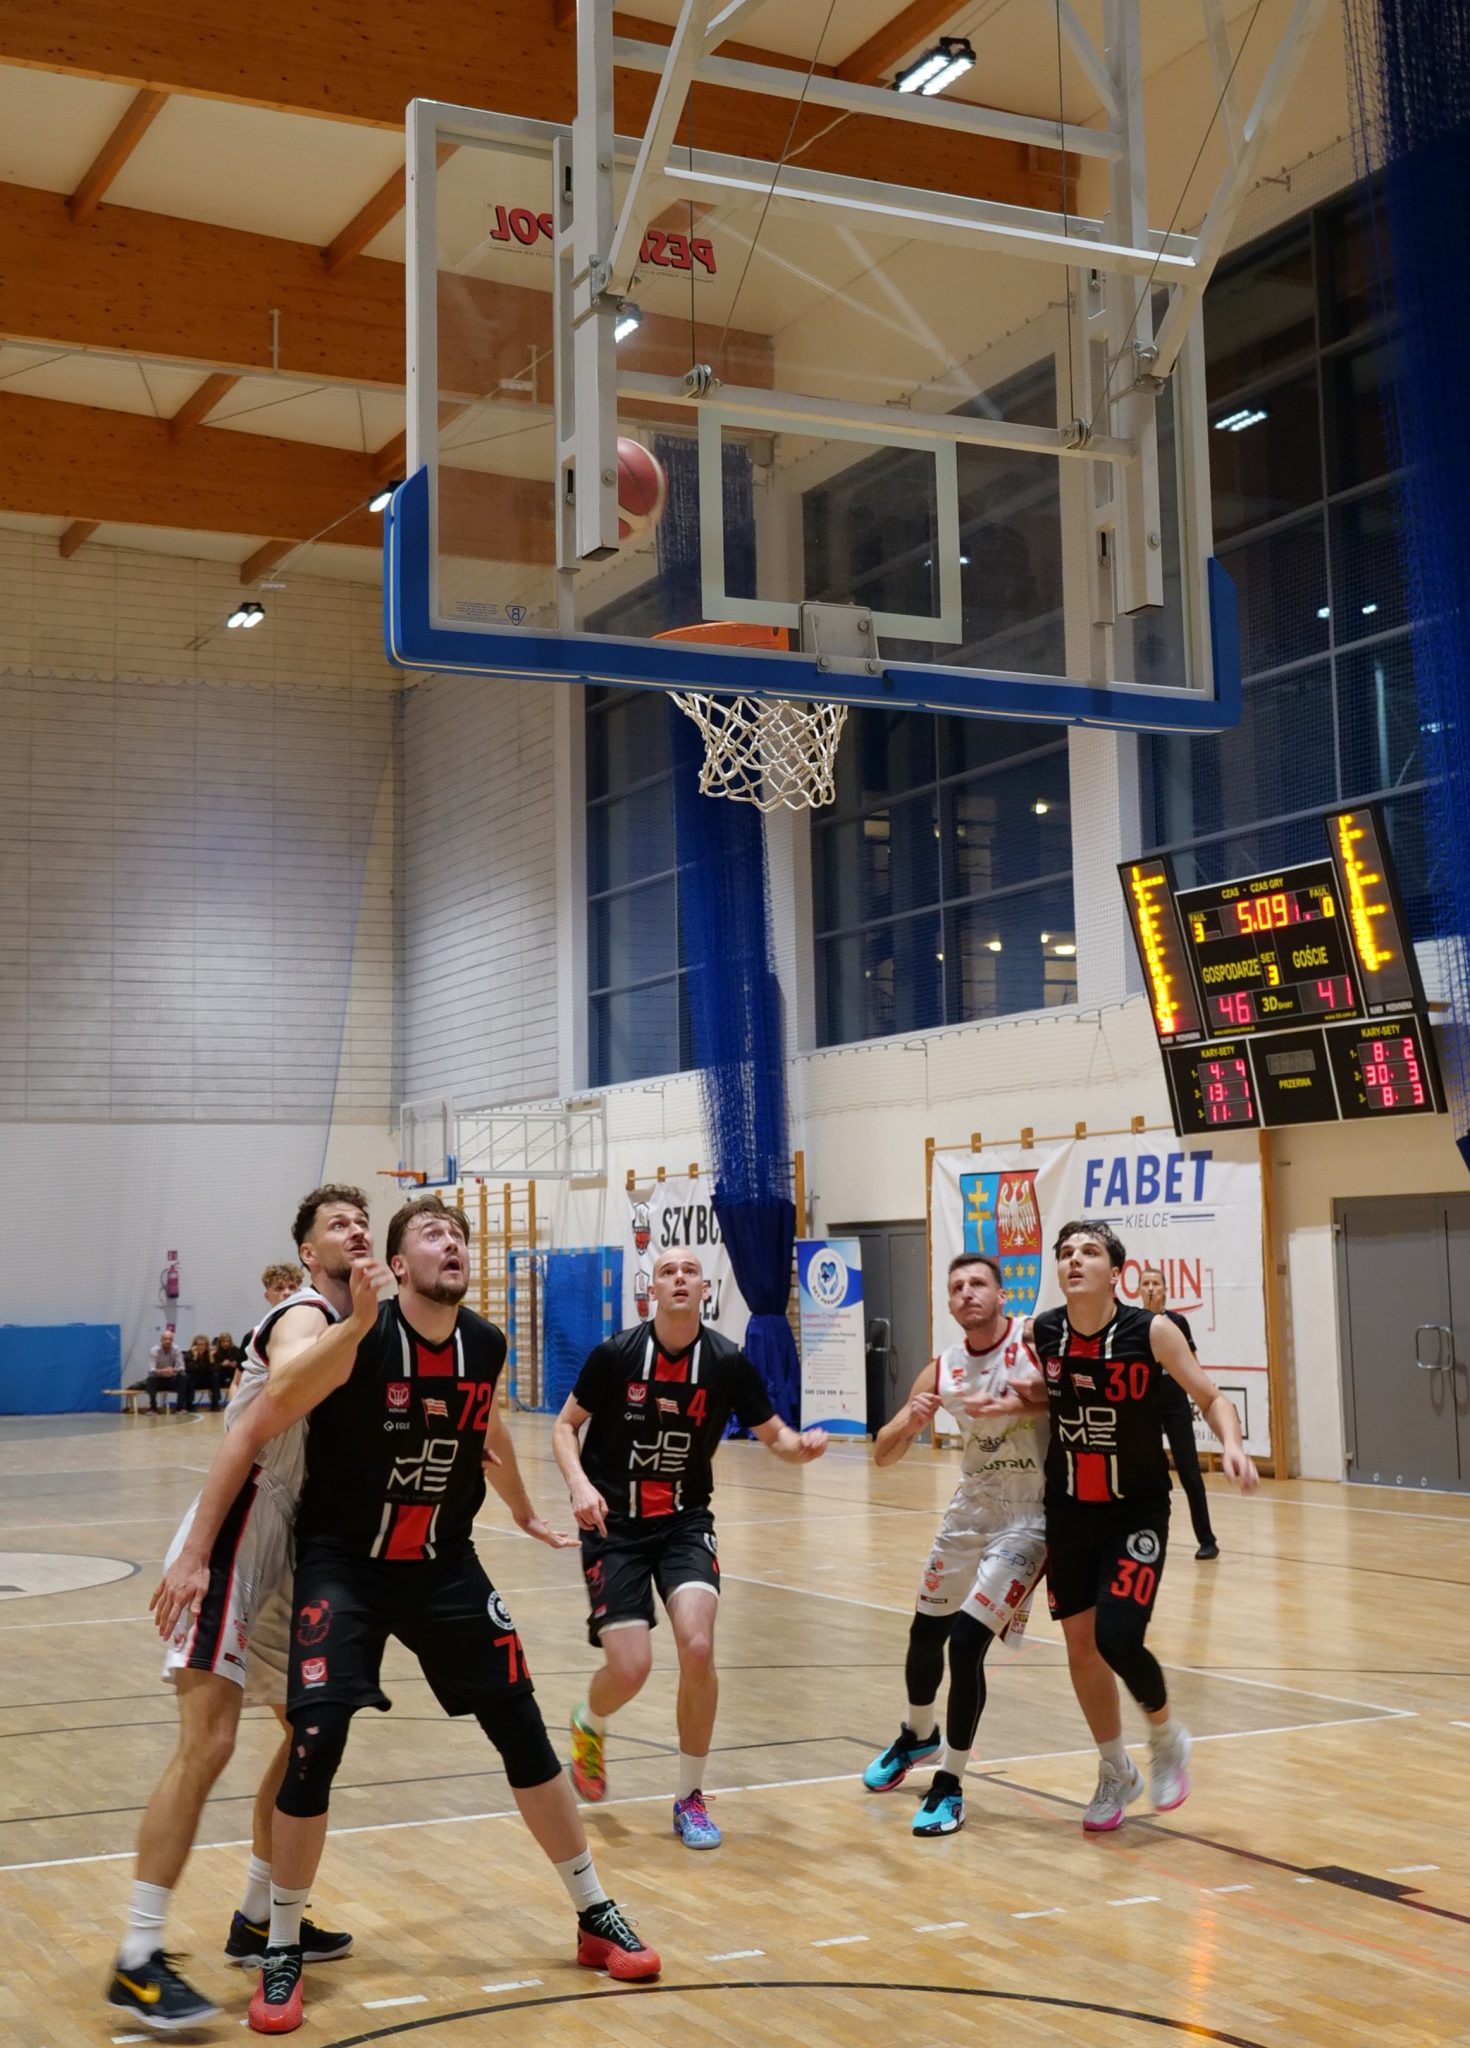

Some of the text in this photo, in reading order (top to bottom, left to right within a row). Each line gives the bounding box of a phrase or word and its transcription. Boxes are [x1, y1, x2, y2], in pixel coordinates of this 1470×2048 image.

[1221, 887, 1240, 899] CZAS
[1202, 957, 1261, 984] GOSPODARZE
[1260, 951, 1275, 964] SET
[1292, 945, 1329, 969] GOŚCIE
[1218, 992, 1251, 1024] 46
[1084, 1150, 1213, 1208] FABET
[661, 1205, 725, 1247] SZYBC
[1125, 1212, 1170, 1229] KIELCE
[1104, 1362, 1149, 1402] 30
[456, 1382, 492, 1431] 72
[686, 1388, 707, 1427] 4
[395, 1422, 410, 1430] EGLE
[1111, 1558, 1155, 1606] 30
